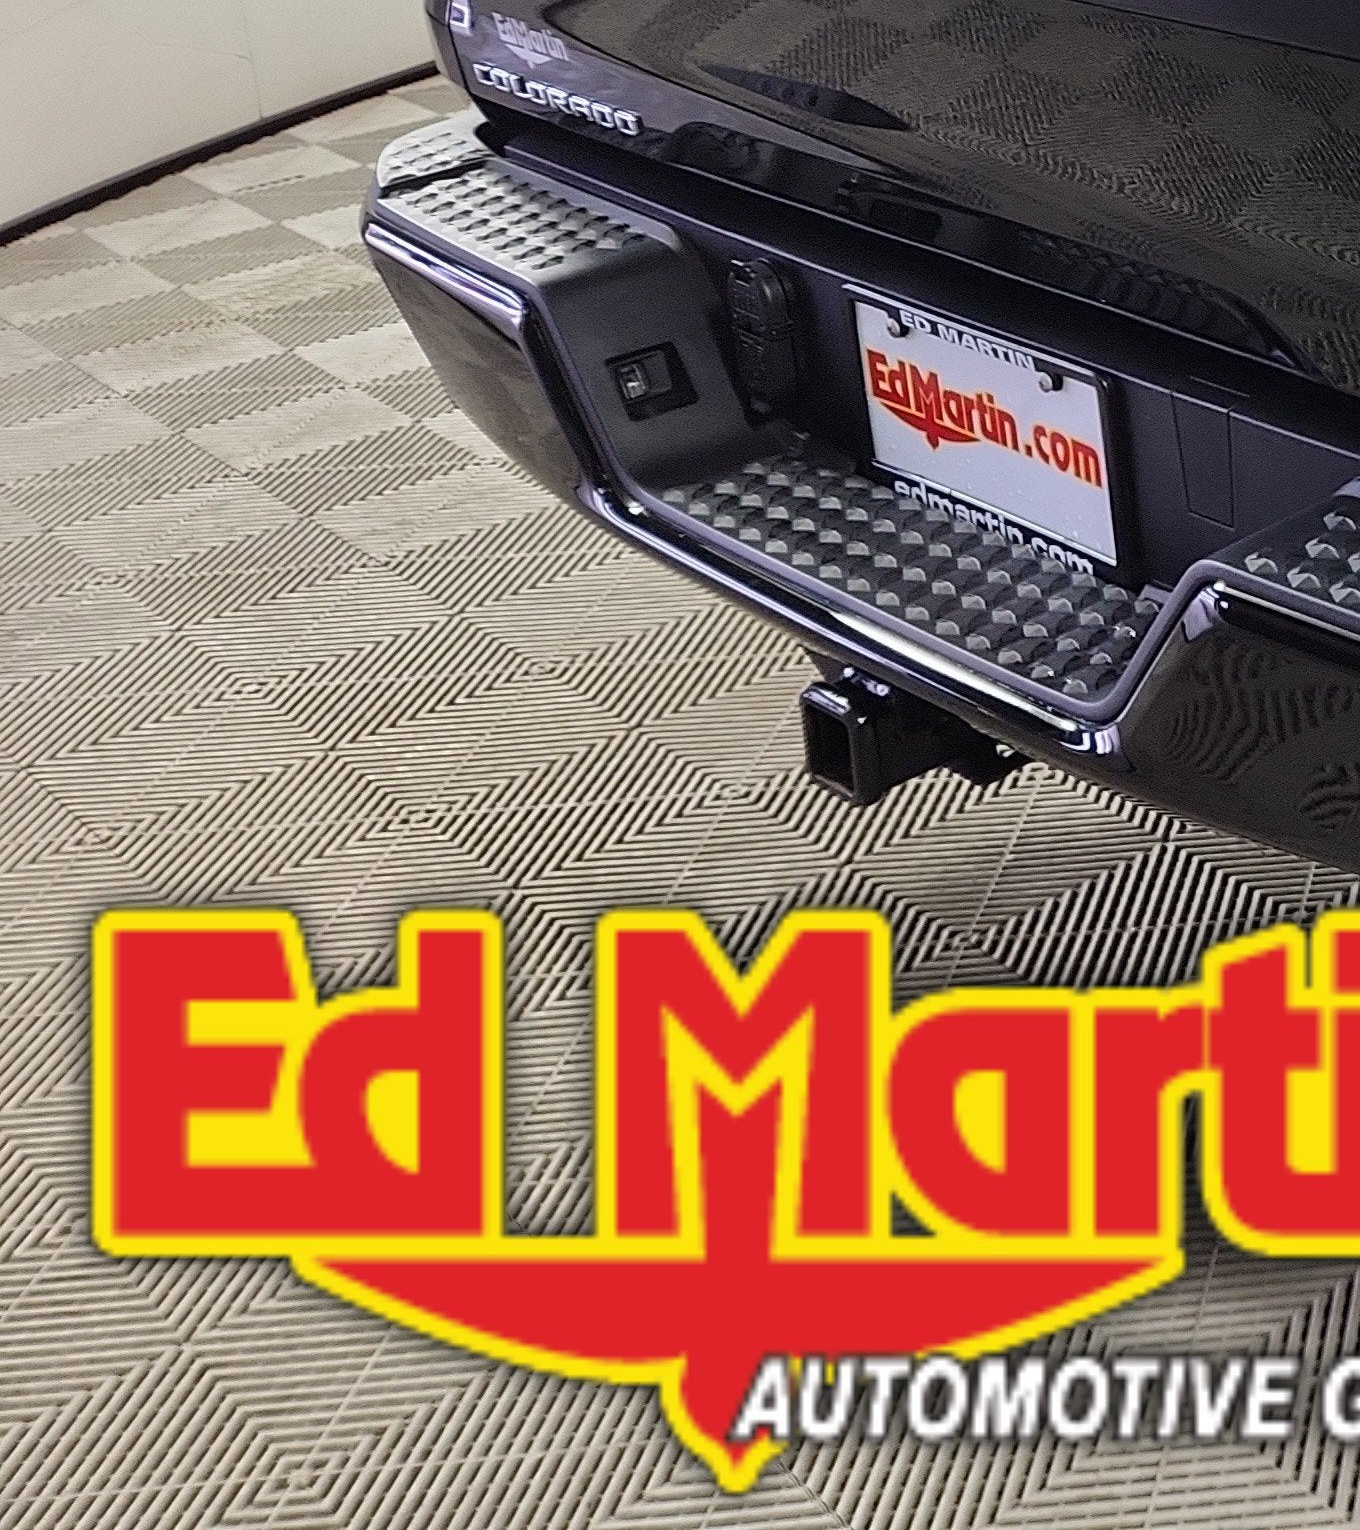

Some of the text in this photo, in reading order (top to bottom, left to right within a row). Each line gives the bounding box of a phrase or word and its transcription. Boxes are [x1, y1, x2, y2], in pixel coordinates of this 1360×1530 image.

[473, 62, 642, 137] COLORADO
[898, 309, 1036, 371] ED MARTIN
